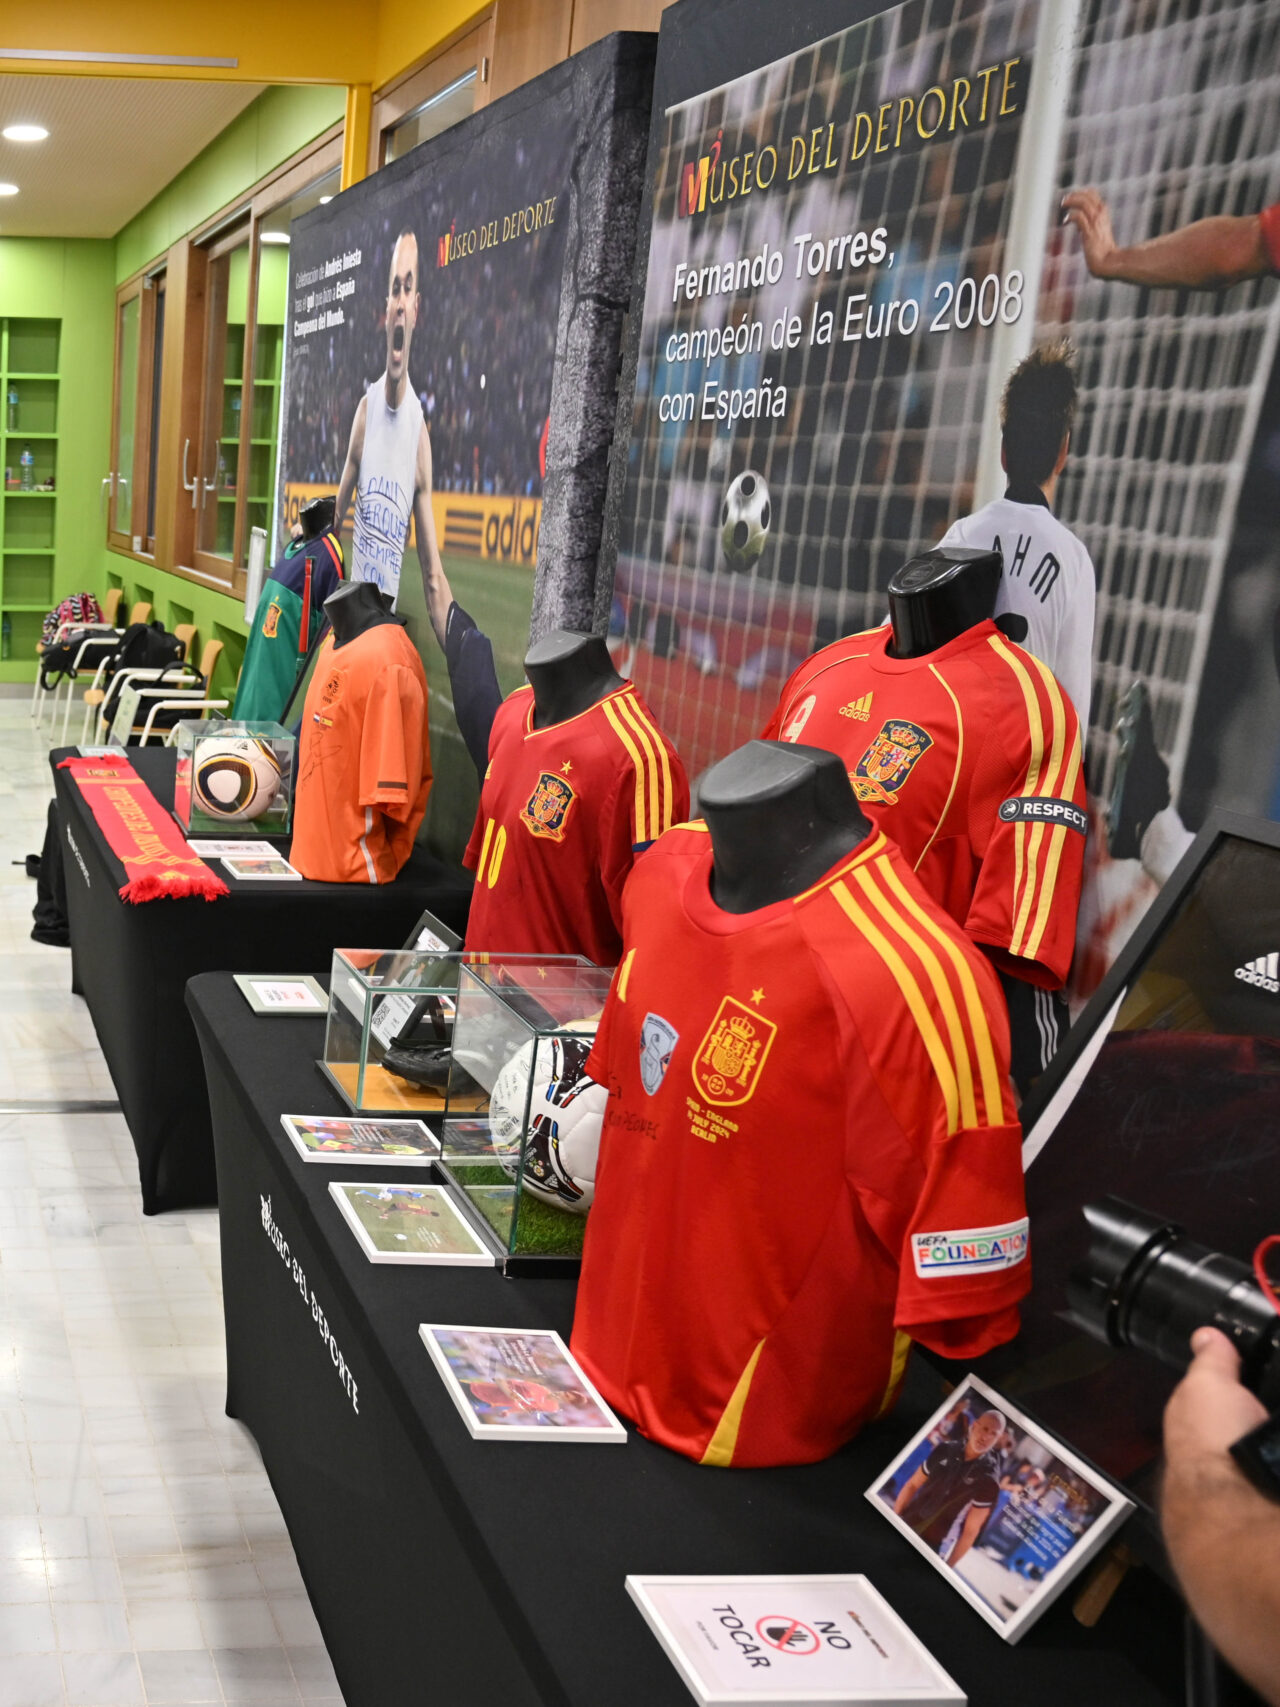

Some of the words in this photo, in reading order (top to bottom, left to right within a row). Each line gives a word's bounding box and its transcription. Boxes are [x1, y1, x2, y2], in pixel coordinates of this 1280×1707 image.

[678, 138, 777, 218] MUSEO
[787, 123, 838, 181] DEL
[851, 57, 1020, 161] DEPORTE
[480, 220, 498, 250] DEL
[502, 196, 557, 242] DEPORTE
[343, 248, 361, 271] Iniesta
[673, 243, 784, 302] Fernando
[794, 227, 895, 279] Torres,
[336, 277, 355, 302] España
[666, 314, 762, 367] campeón
[771, 315, 801, 350] de
[810, 302, 832, 346] la
[843, 294, 919, 342] Euro
[930, 270, 1023, 333] 2008
[659, 392, 694, 422] con
[701, 378, 788, 429] España
[486, 498, 540, 558] adid
[838, 706, 871, 722] adidas
[1023, 802, 1087, 828] RESPECT
[477, 818, 507, 889] 10
[1234, 967, 1279, 993] adidas
[918, 1233, 1027, 1262] FOUNDATION
[292, 1257, 309, 1305] DEL
[311, 1290, 359, 1415] DEPORTE
[712, 1604, 772, 1668] TOCAR
[814, 1621, 852, 1650] NO
